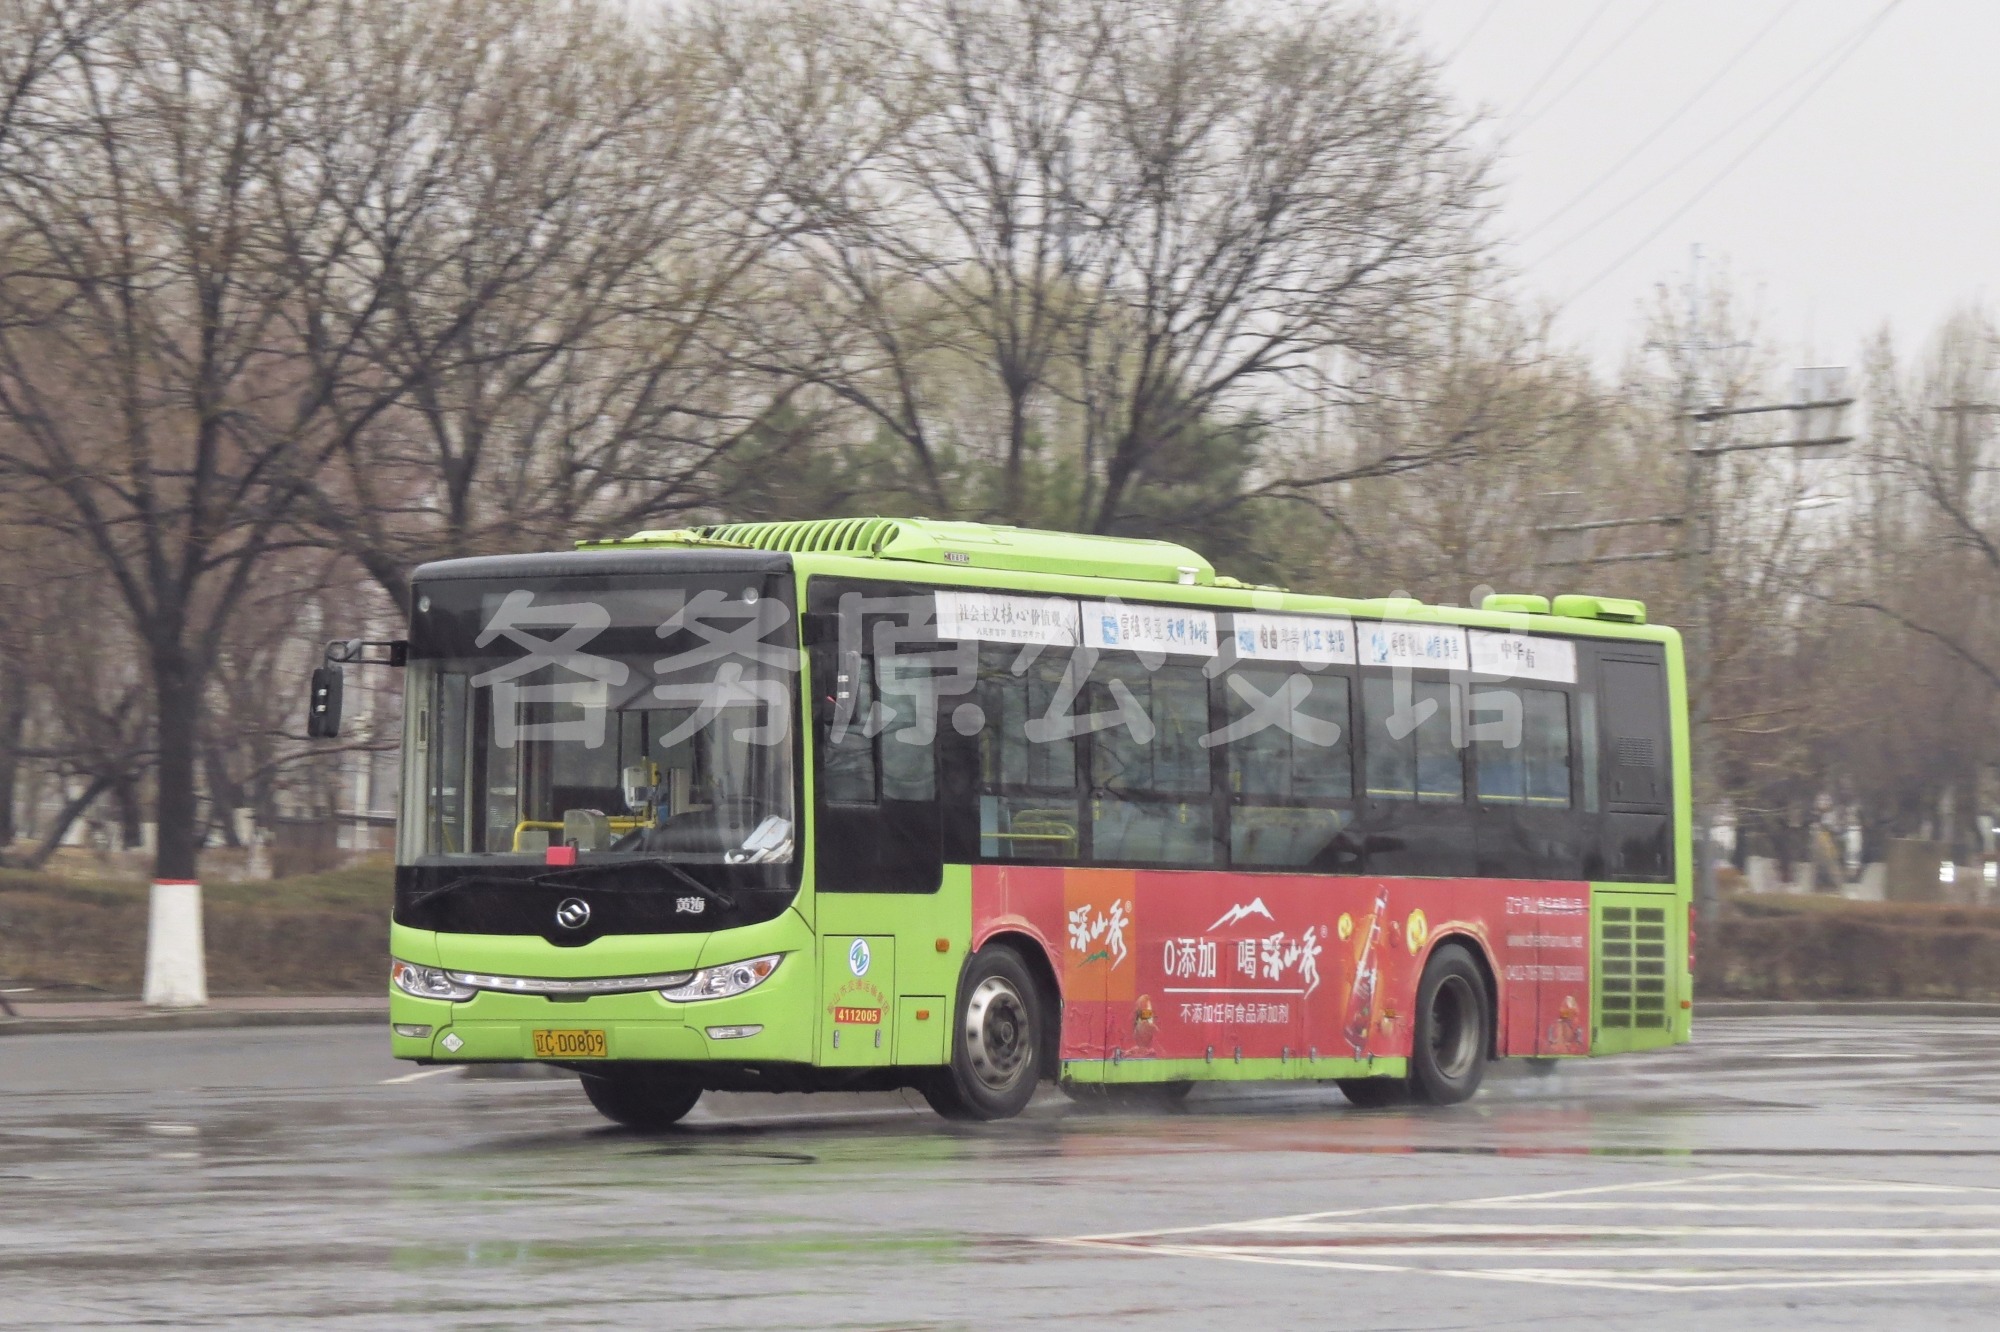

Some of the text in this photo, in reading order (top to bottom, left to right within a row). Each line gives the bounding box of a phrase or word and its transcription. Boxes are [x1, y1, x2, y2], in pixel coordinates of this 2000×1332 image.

[958, 601, 1062, 628] 社会主义核心价值观
[675, 896, 705, 914] 黄海
[838, 1008, 878, 1022] 4112005
[1180, 1003, 1290, 1024] 不添加任何食品添加剂
